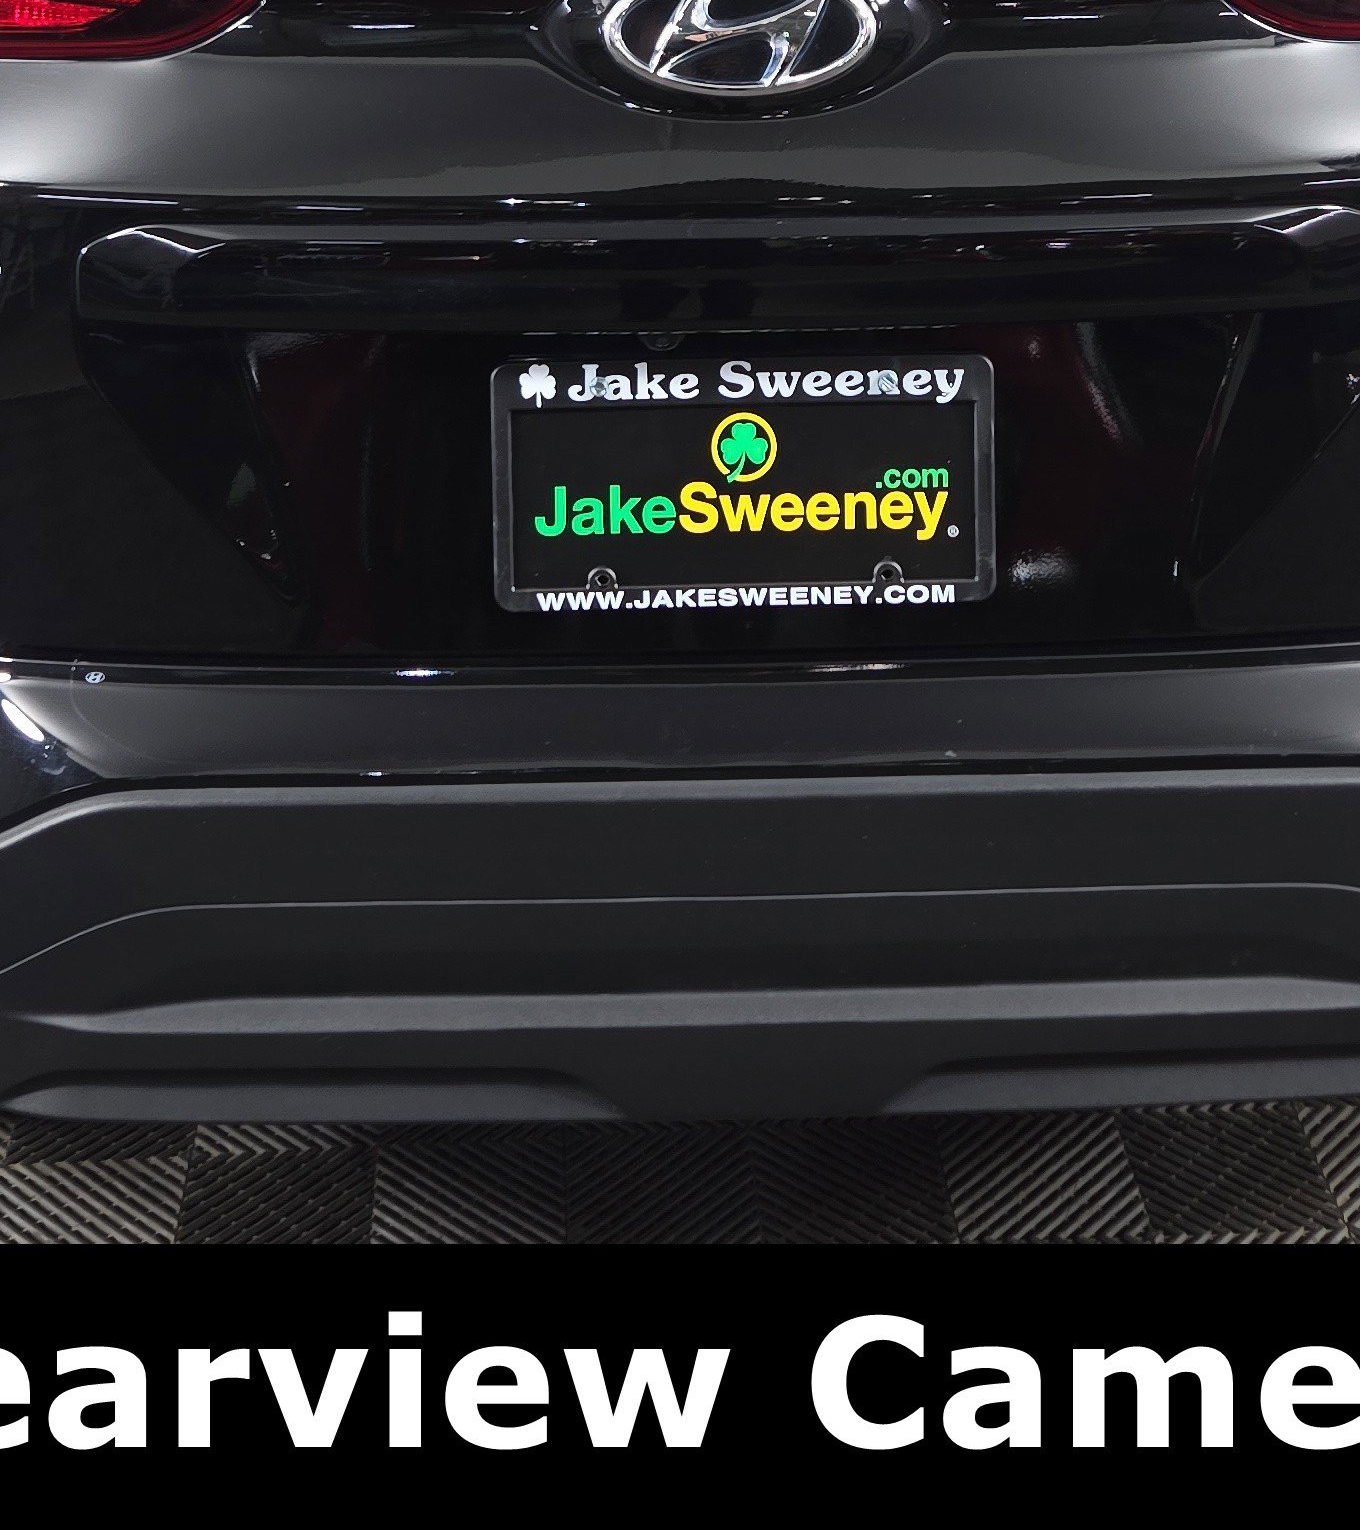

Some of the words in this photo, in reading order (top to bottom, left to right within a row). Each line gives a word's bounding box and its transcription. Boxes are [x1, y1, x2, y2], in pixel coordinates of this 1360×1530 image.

[568, 362, 700, 402] Jake
[718, 360, 965, 404] Sweeney
[536, 584, 956, 612] WWW.JAKESWEENEY.COM
